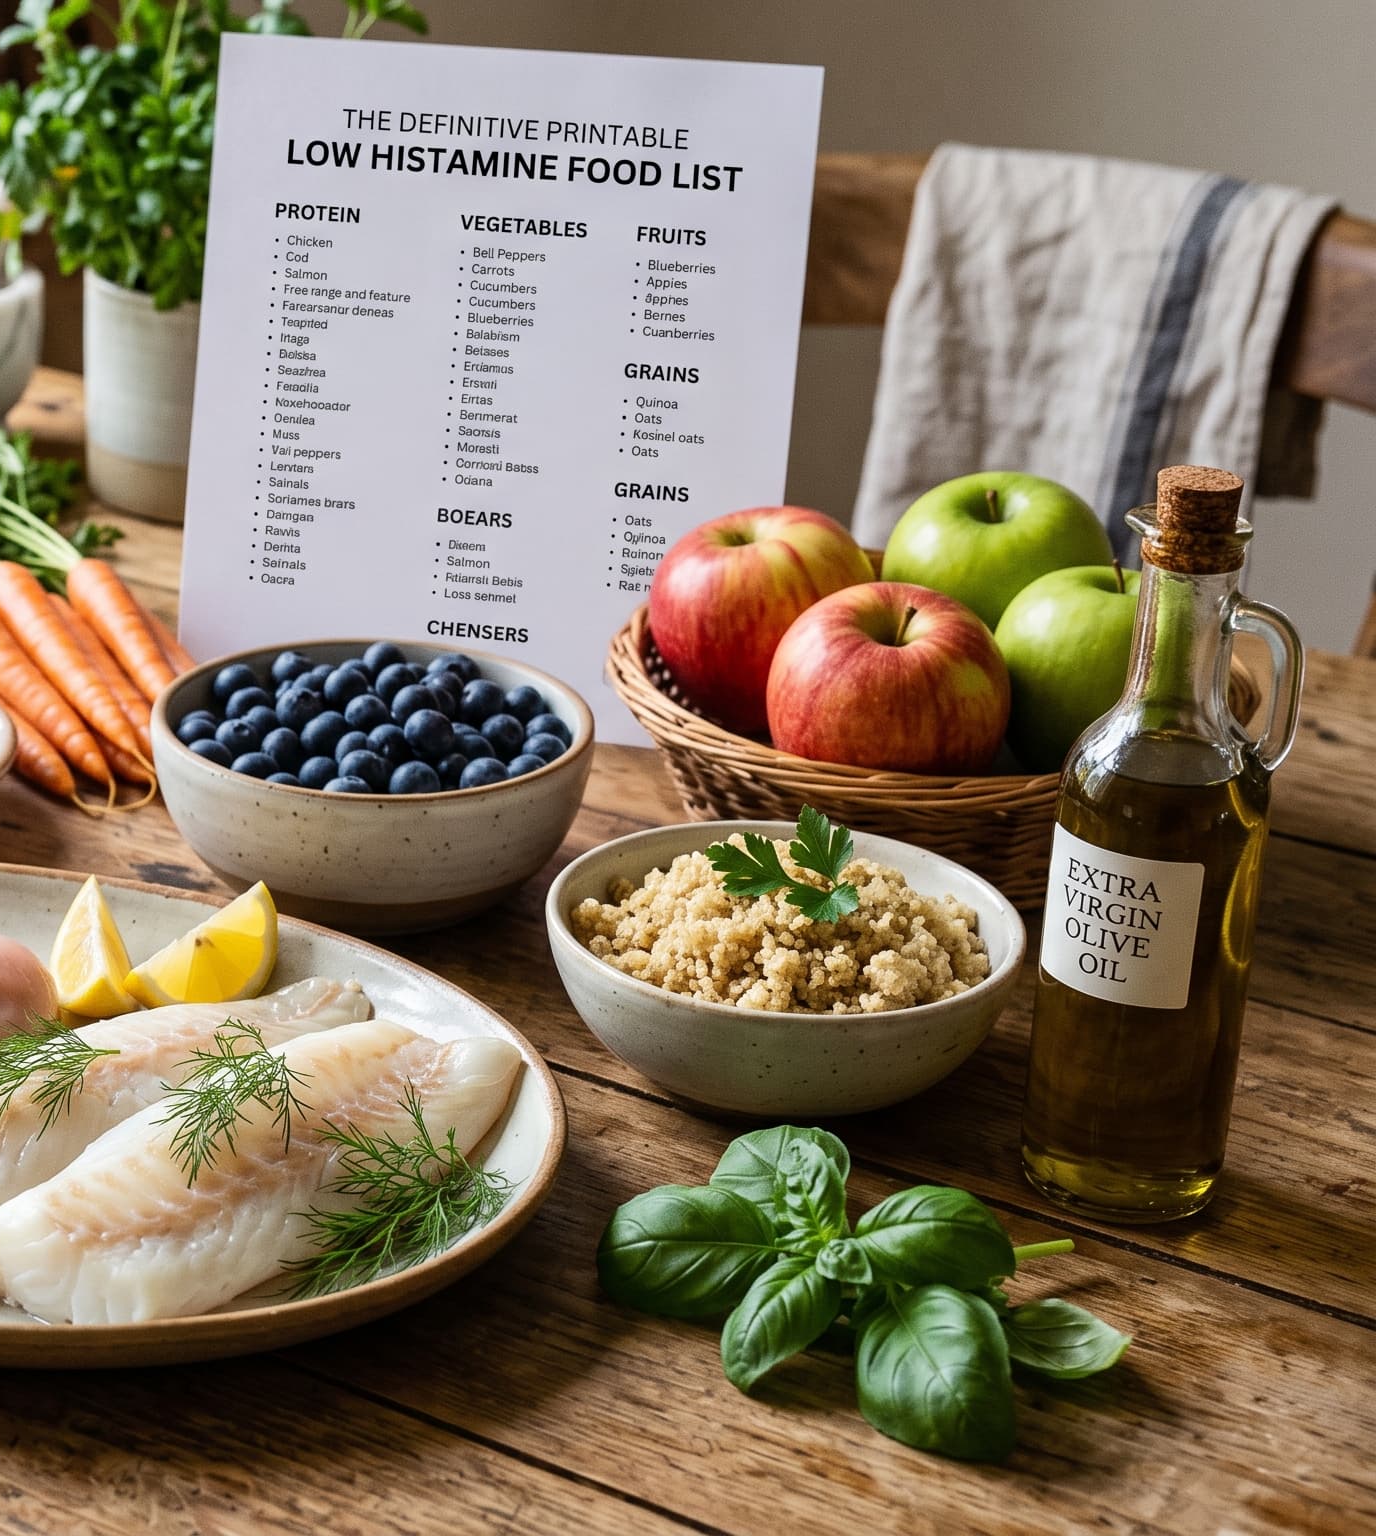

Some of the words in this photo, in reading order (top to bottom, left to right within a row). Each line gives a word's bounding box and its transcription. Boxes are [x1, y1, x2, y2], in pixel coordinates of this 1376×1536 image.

[343, 109, 392, 131] THE
[400, 112, 539, 140] DEFINITIVE
[547, 121, 689, 150] PRINTABLE
[287, 139, 362, 168] LOW
[371, 144, 558, 180] HISTAMINE
[568, 156, 662, 186] FOOD
[673, 162, 743, 192] LIST
[275, 202, 360, 223] PROTEIN
[460, 214, 587, 238] VEGETABLES
[287, 235, 333, 248] Chicken
[637, 225, 706, 246] FRUITS
[286, 251, 309, 263] Cod
[473, 247, 494, 259] Bell
[498, 249, 546, 263] Peppers
[285, 268, 327, 280] Salmon
[472, 264, 515, 276] Carrots
[648, 259, 716, 274] Blueberries
[284, 284, 308, 296] Free
[311, 287, 342, 300] range
[345, 289, 366, 299] and
[369, 290, 411, 303] feature
[470, 280, 537, 294] Cucumbers
[469, 296, 535, 310] Cucumbers
[468, 312, 534, 327] Blueberries
[624, 363, 699, 384] GRAINS
[636, 396, 678, 409] Quinoa
[635, 413, 662, 424] Oats
[273, 429, 300, 440] Muss
[678, 434, 704, 444] oats
[294, 448, 341, 460] peppers
[632, 445, 659, 458] Oats
[614, 482, 689, 502] GRAINS
[437, 508, 512, 528] BOEARS
[625, 515, 652, 527] Oats
[447, 556, 490, 568] Salmon
[444, 588, 471, 600] Loss
[427, 620, 528, 643] CHENSERS
[1067, 857, 1161, 903] EXTRA
[1064, 883, 1162, 931] VIRGIN
[1065, 916, 1150, 958] OLIVE
[1079, 952, 1127, 983] OIL
